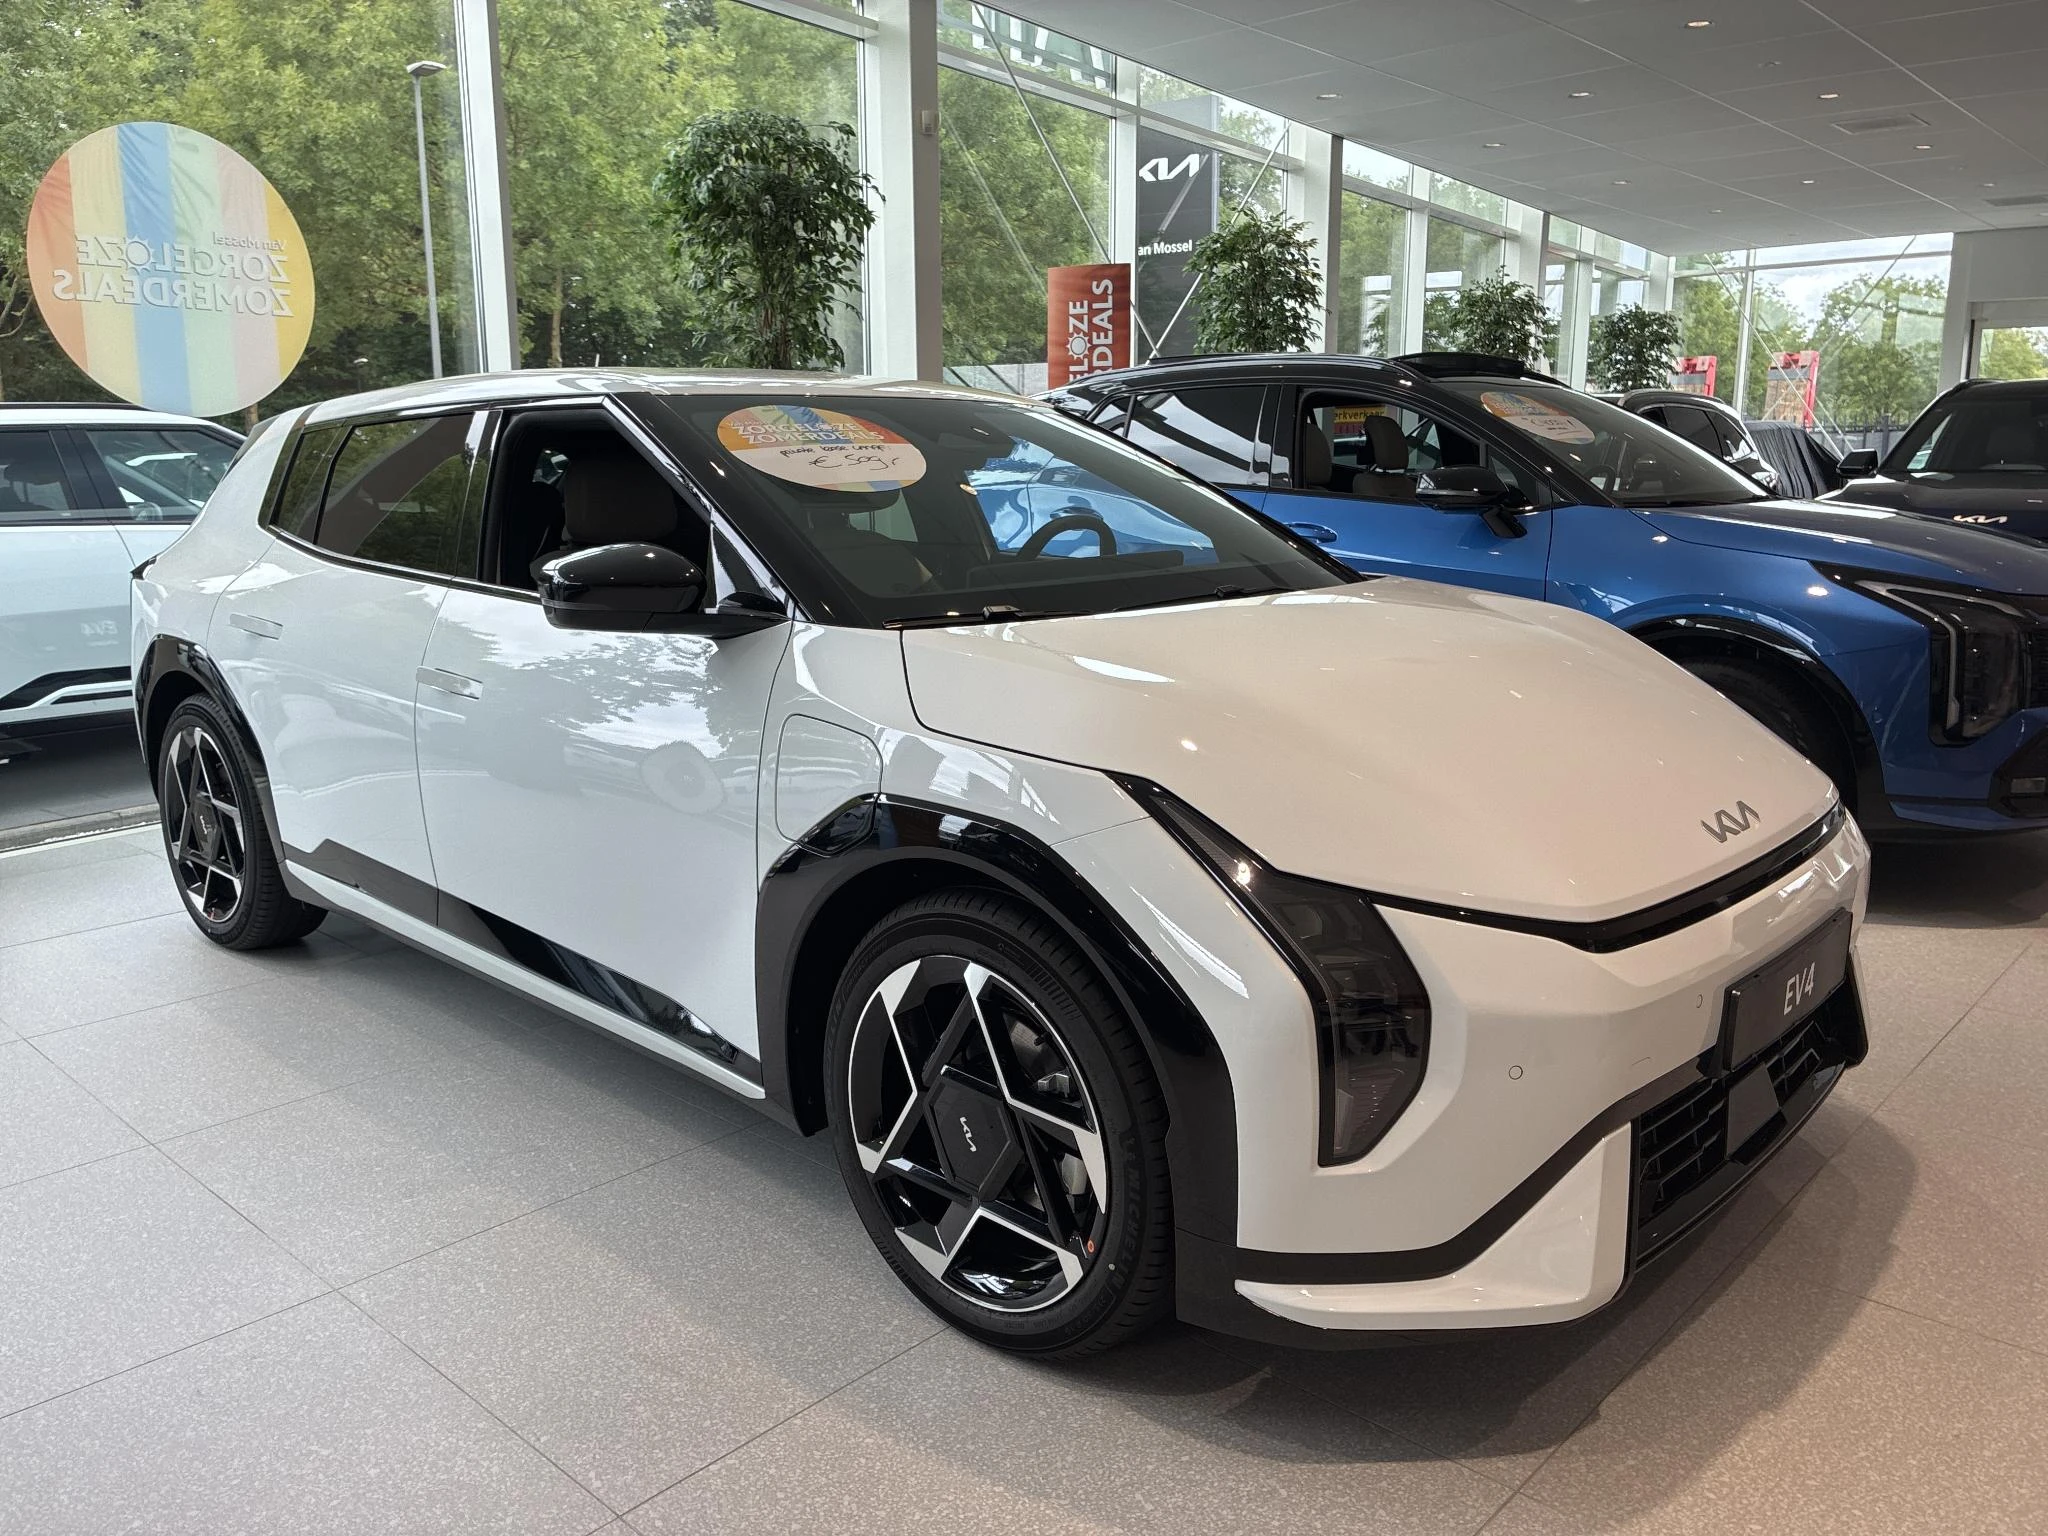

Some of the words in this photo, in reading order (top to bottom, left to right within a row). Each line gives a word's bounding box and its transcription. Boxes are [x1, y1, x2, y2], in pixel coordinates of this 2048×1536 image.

[1153, 239, 1193, 254] Mossel
[1092, 279, 1114, 374] DEALS
[741, 431, 886, 444] ZOMERDEALS
[1700, 800, 1761, 843] KIA
[1783, 962, 1815, 1016] EV4
[1111, 1166, 1142, 1291] MICHELIN
